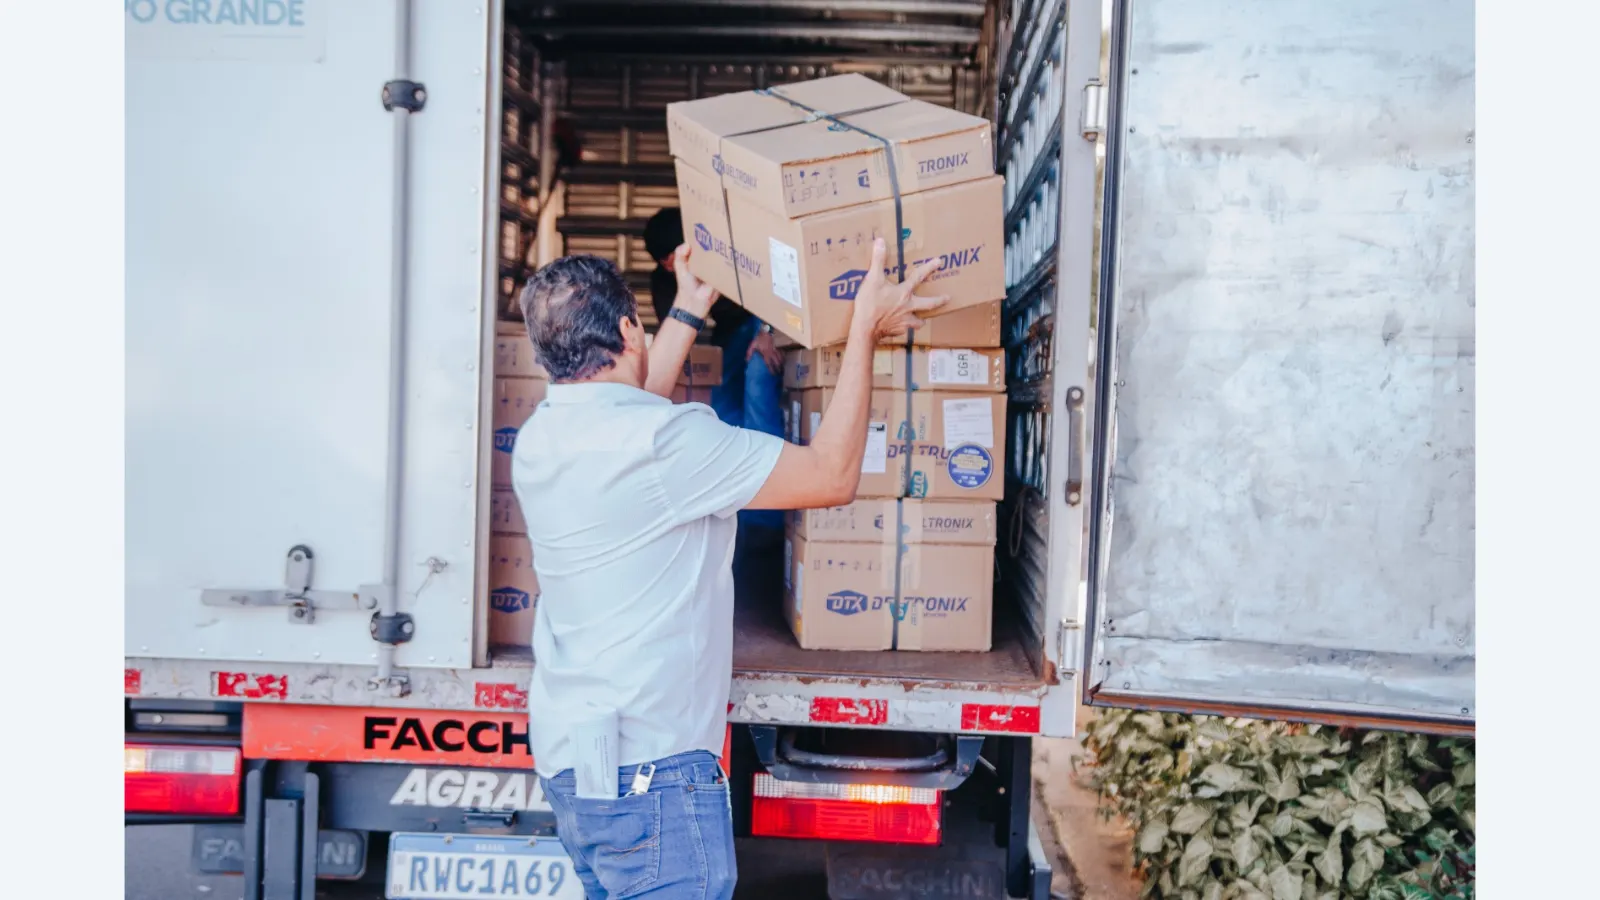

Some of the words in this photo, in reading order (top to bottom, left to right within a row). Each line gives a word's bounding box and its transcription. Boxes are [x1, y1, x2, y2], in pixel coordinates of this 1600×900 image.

[165, 0, 305, 26] GRANDE
[958, 353, 969, 377] CGR
[827, 592, 867, 614] DTX
[409, 856, 565, 897] RWC1A69
